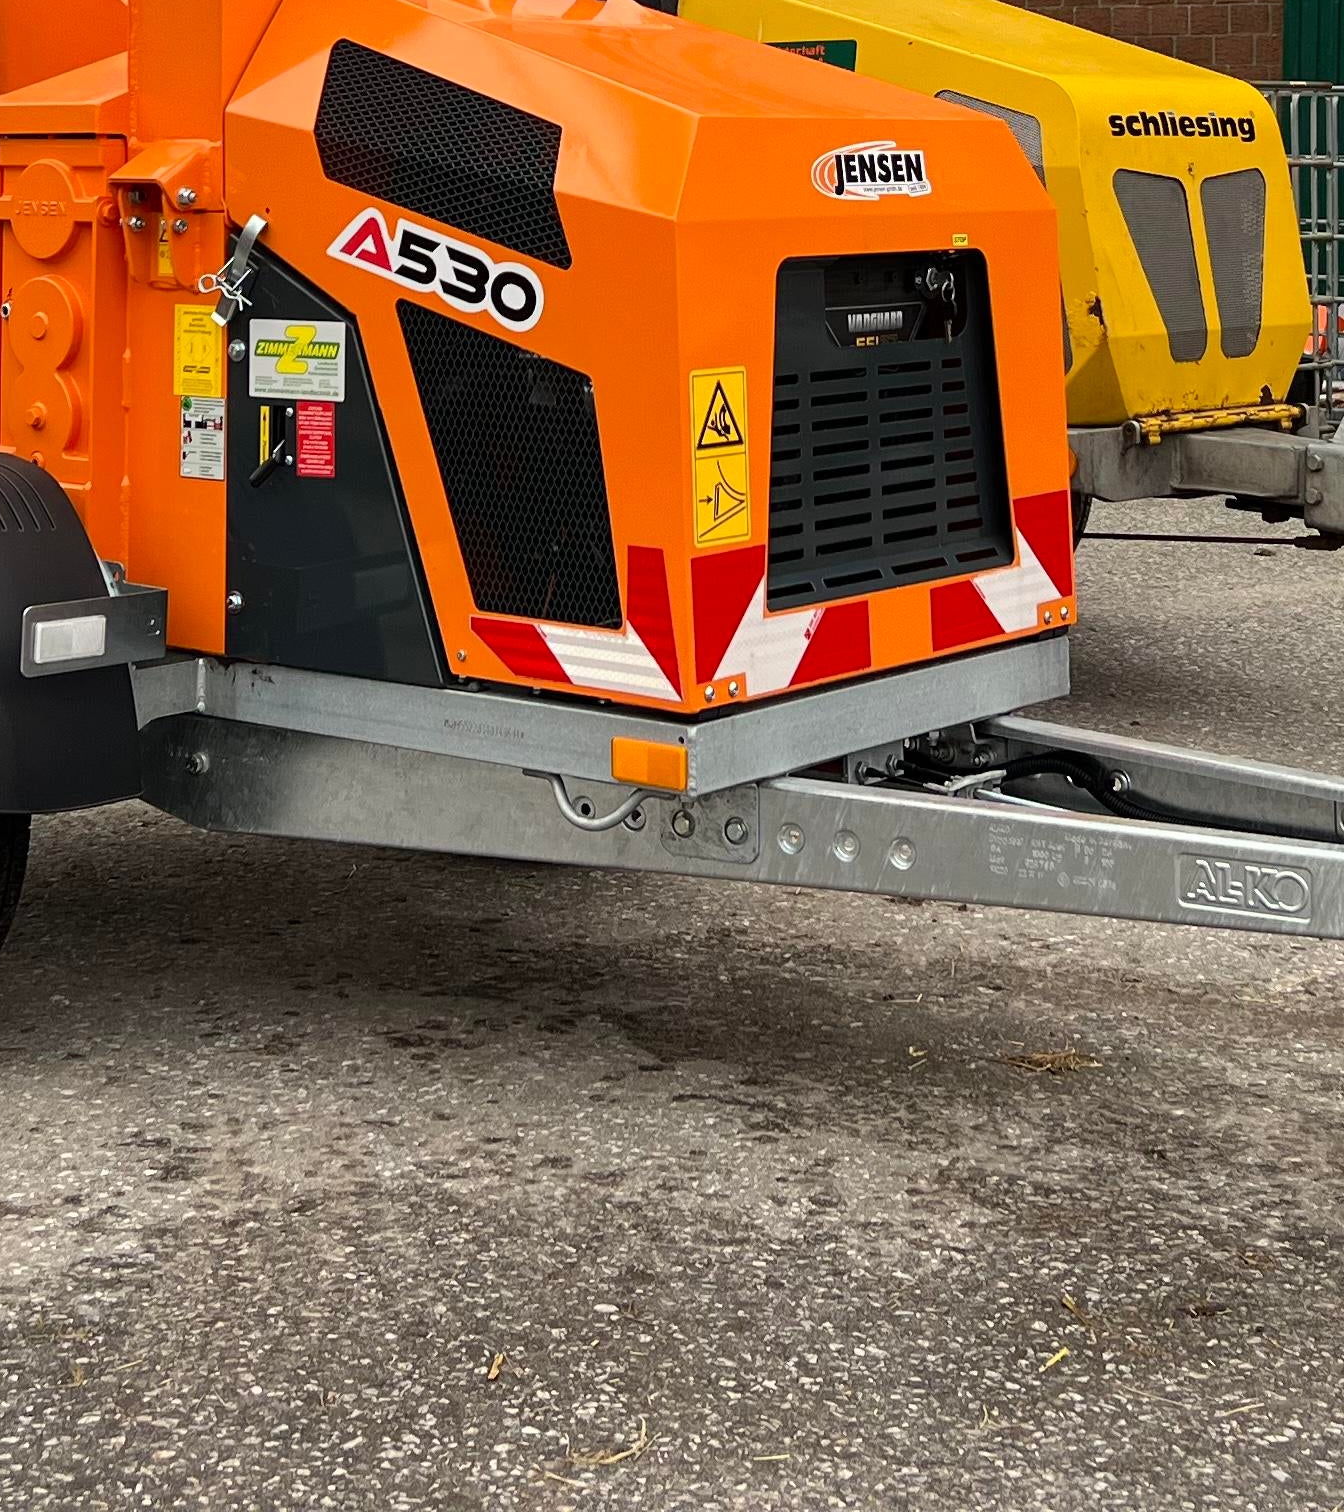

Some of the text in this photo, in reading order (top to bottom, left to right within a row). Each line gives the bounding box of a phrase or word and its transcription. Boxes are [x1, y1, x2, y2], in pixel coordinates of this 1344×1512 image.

[1109, 111, 1256, 142] schliesing
[834, 153, 923, 195] JENSEN
[16, 199, 67, 216] JENSEN
[340, 217, 537, 322] A530
[847, 310, 904, 333] VANGUARD
[1186, 859, 1309, 913] AL-KO
